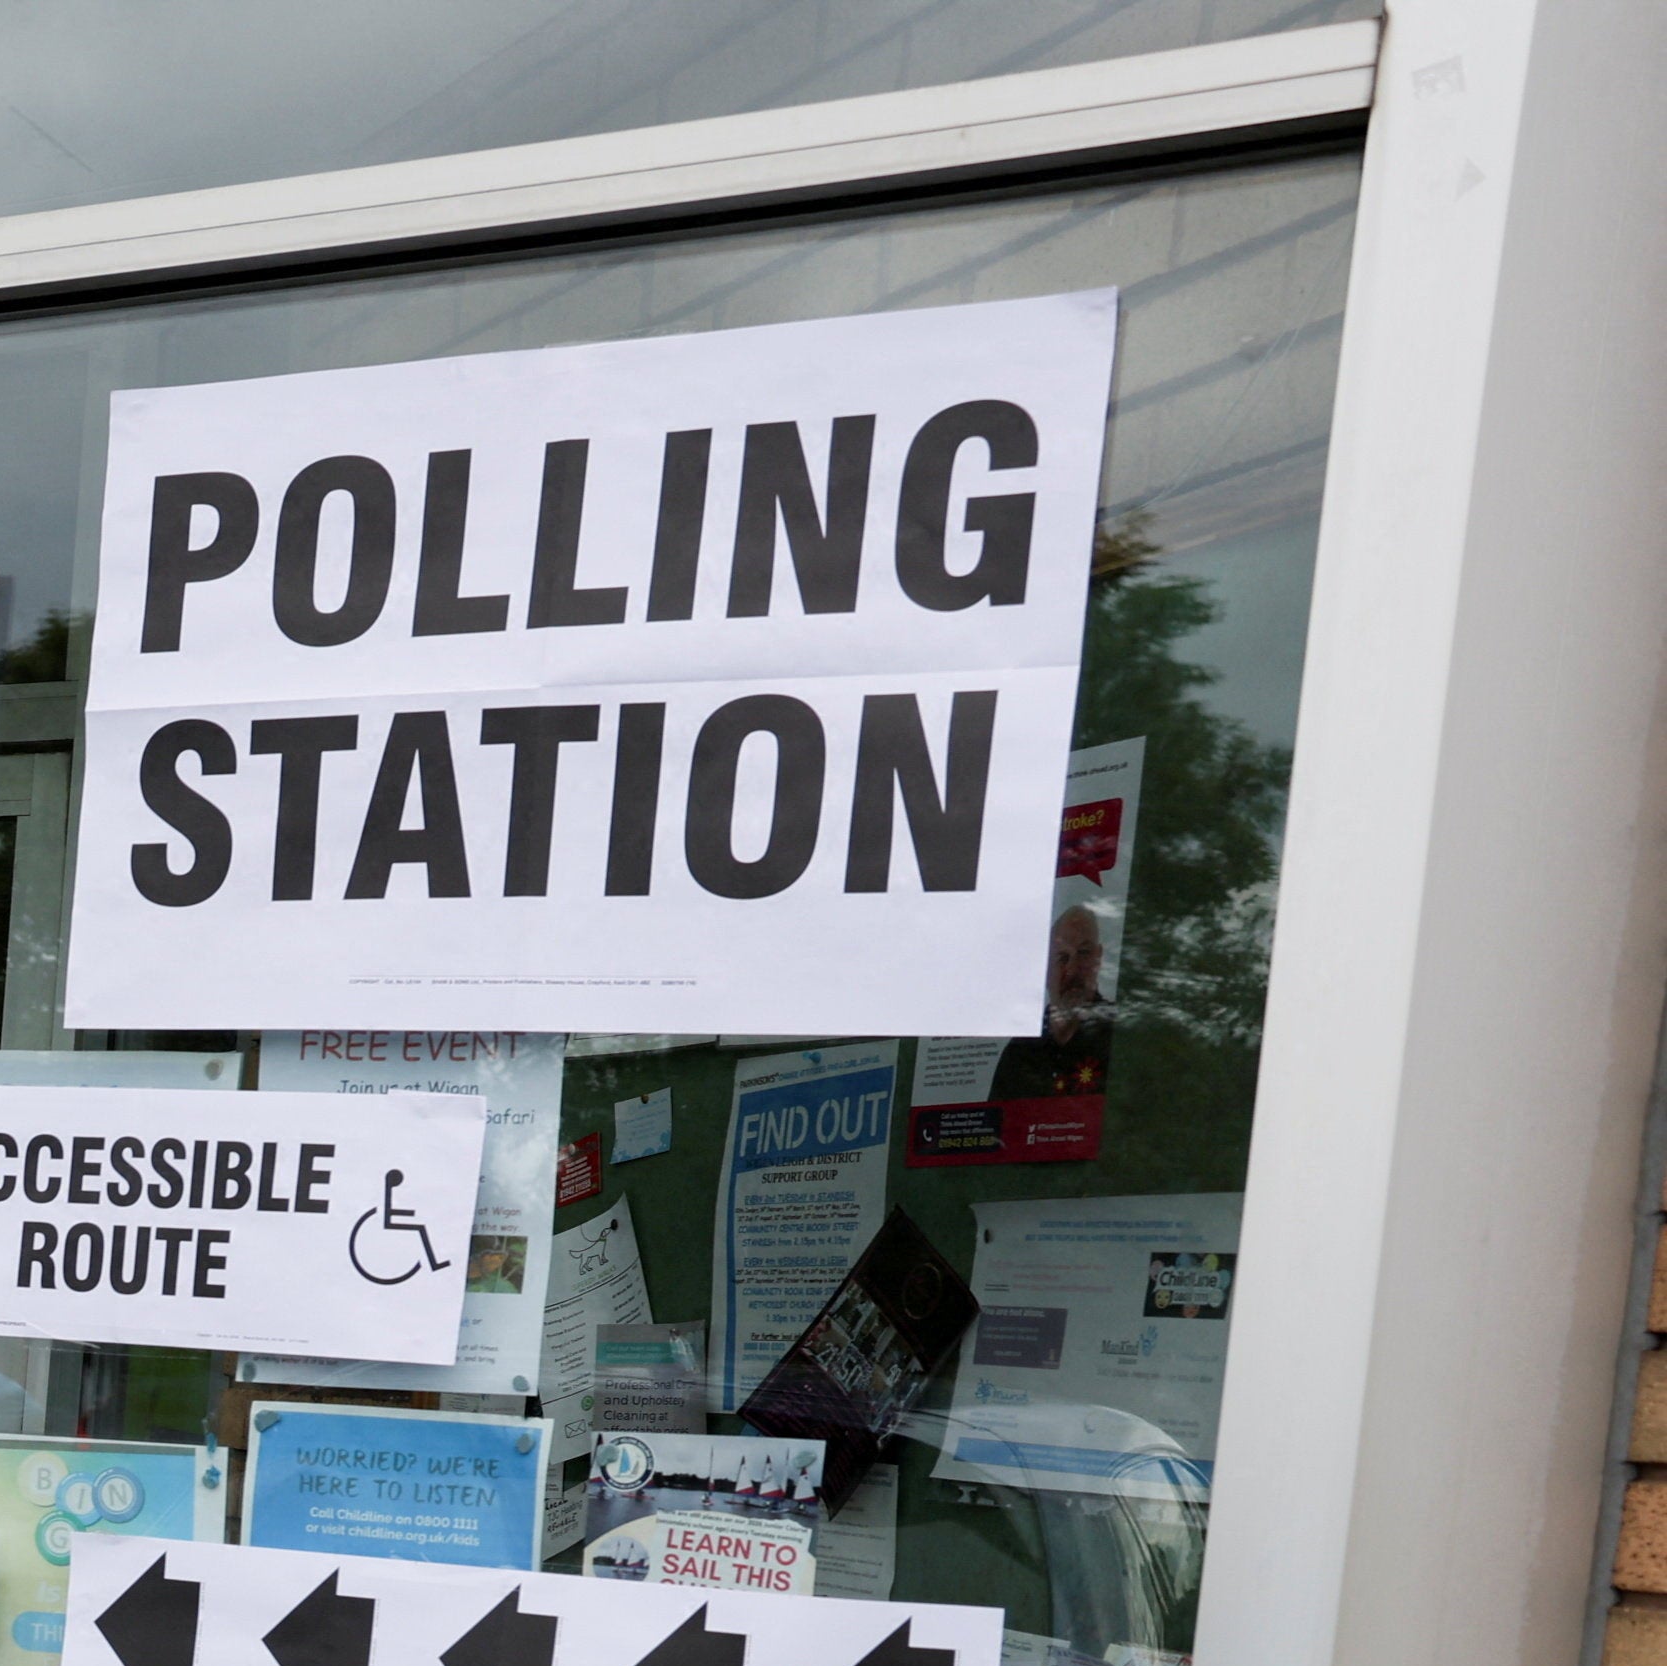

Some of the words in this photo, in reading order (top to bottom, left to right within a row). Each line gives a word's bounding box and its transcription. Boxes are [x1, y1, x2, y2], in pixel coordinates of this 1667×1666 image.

[140, 398, 1039, 654] POLLING
[129, 689, 998, 907] STATION
[300, 1031, 390, 1061] FREE
[402, 1031, 526, 1061] EVENT
[337, 1080, 374, 1094] Join
[485, 1109, 535, 1126] Safari
[740, 1105, 809, 1157] FIND
[816, 1090, 888, 1145] OUT
[817, 1151, 863, 1166] DISTRICT
[761, 1170, 802, 1185] SUPPORT
[804, 1168, 839, 1182] GROUP
[17, 1220, 231, 1299] ROUTE
[604, 1395, 627, 1405] and
[603, 1410, 657, 1423] Cleaning
[658, 1411, 668, 1421] at
[296, 1447, 416, 1473] WORRIED?
[427, 1456, 502, 1479] WE'RE
[299, 1475, 359, 1497] HERE
[374, 1479, 402, 1501] TO
[415, 1483, 496, 1507] LISTEN
[310, 1506, 334, 1518] Call
[336, 1508, 392, 1523] Childline
[396, 1515, 412, 1525] on
[416, 1515, 450, 1528] 0800
[454, 1517, 478, 1530] 1111
[306, 1523, 319, 1533] or
[322, 1522, 345, 1535] visit
[348, 1525, 480, 1546] childline.org.uk/kids
[666, 1528, 752, 1559] LEARN
[760, 1541, 797, 1566] TO
[662, 1553, 721, 1581] SAIL
[732, 1563, 792, 1592] THIS
